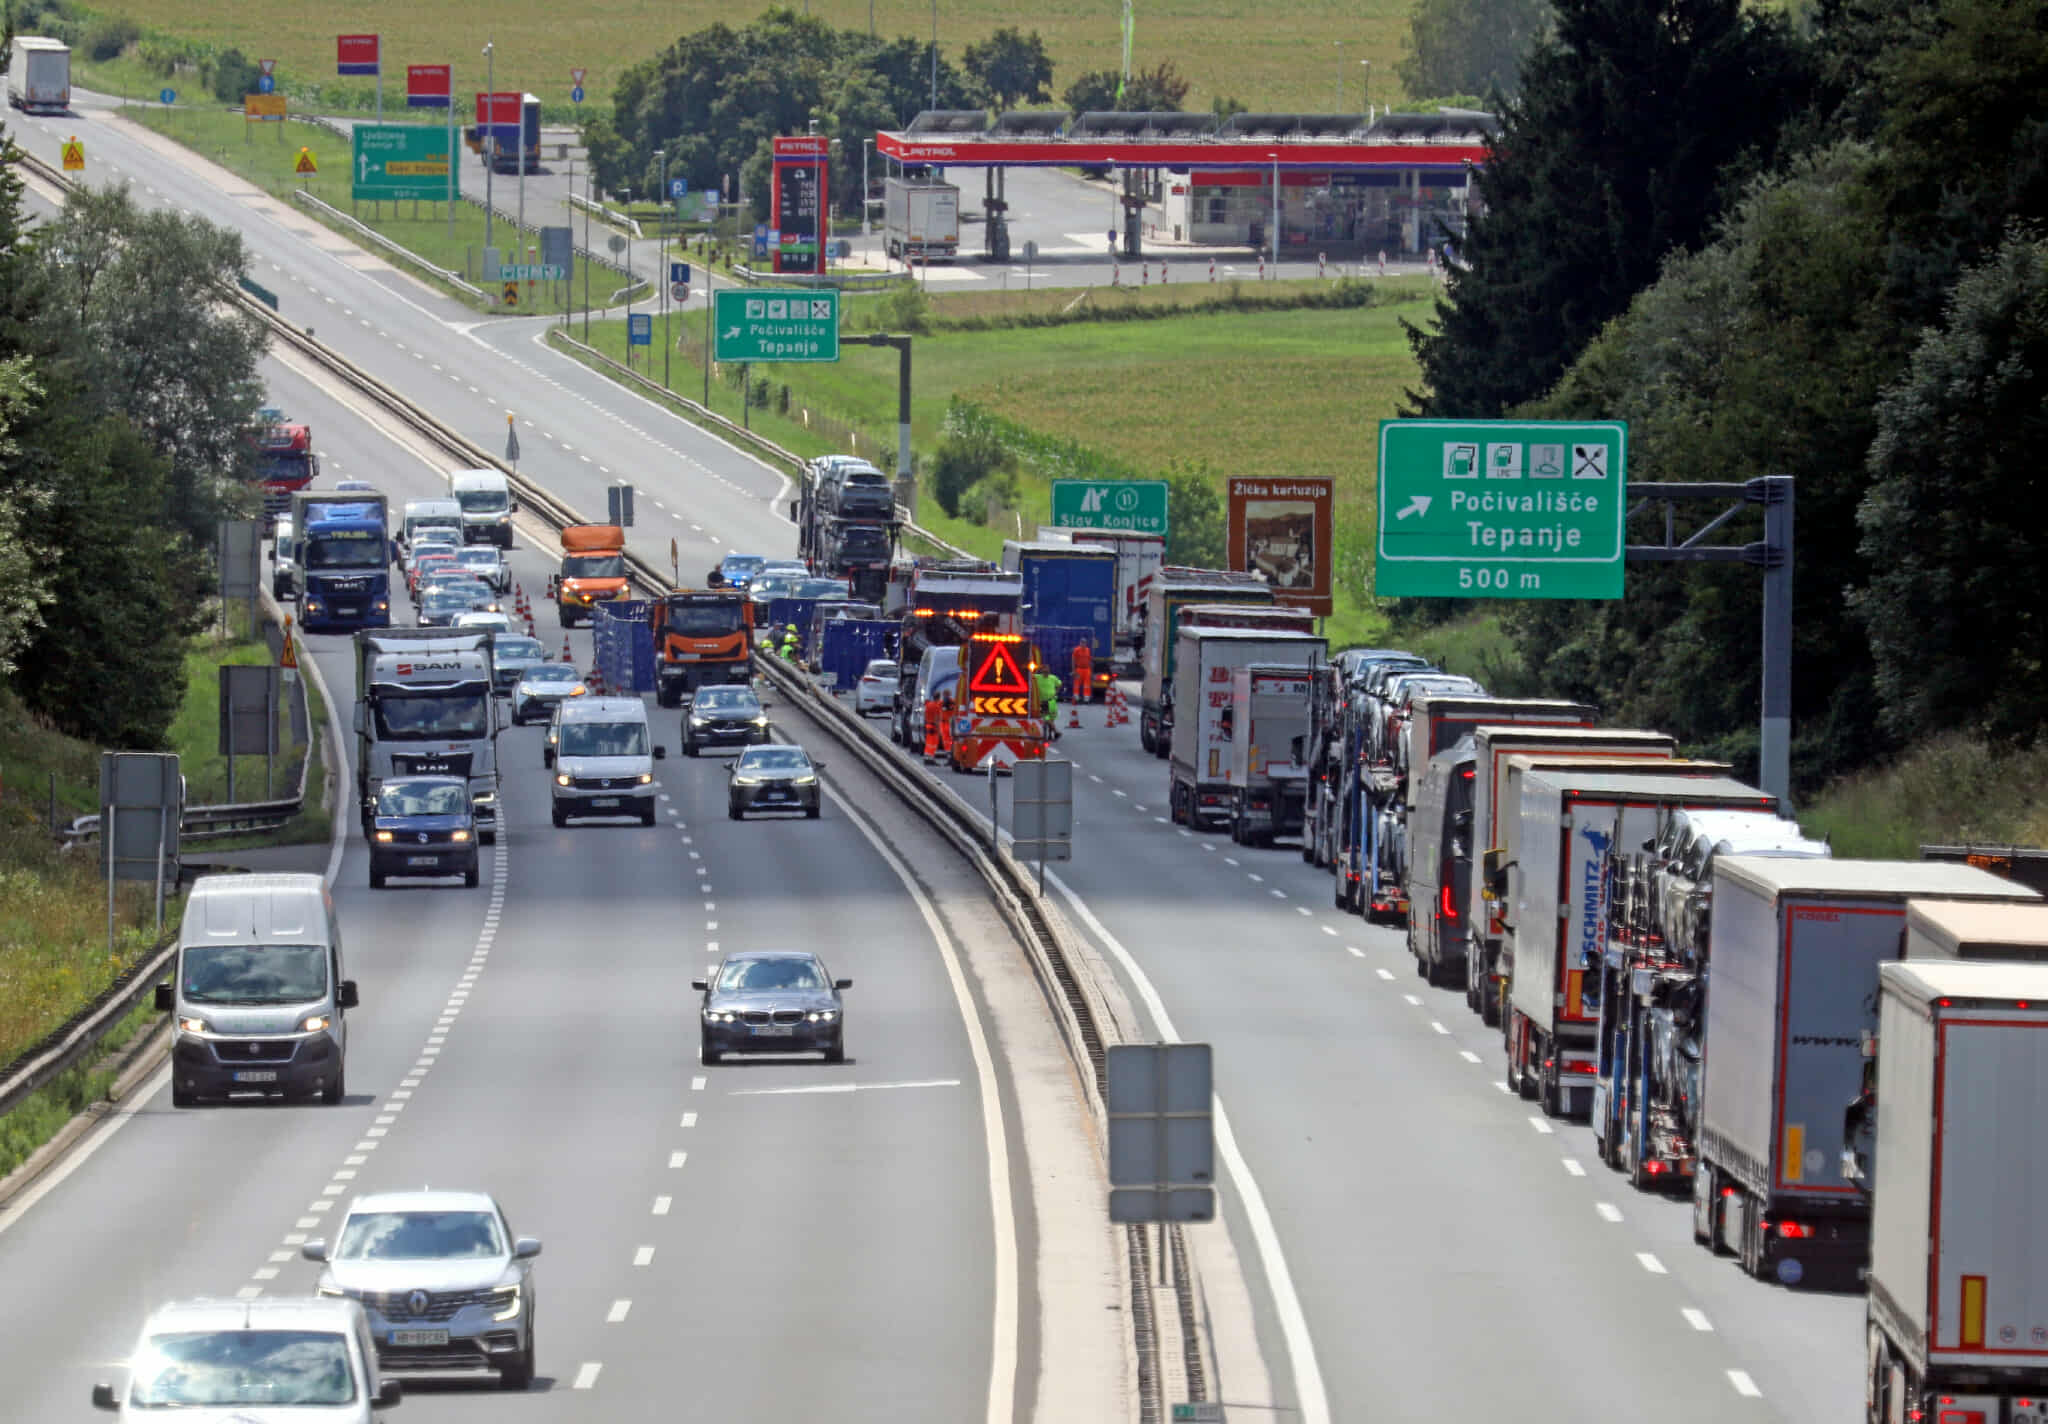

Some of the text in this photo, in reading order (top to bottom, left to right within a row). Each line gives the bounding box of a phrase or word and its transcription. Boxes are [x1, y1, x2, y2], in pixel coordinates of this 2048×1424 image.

[779, 142, 823, 152] PETROL
[910, 147, 957, 157] PETROL
[749, 324, 827, 336] Počivališče
[758, 340, 819, 357] Tepanje
[1234, 482, 1327, 498] Žička kartuzija
[1451, 490, 1599, 512] Počivališče
[1103, 514, 1160, 529] Konjice
[1466, 521, 1582, 552] Tepanje
[1459, 568, 1541, 589] 500 m
[413, 662, 461, 672] SAM
[1582, 859, 1600, 952] SCHMITZ
